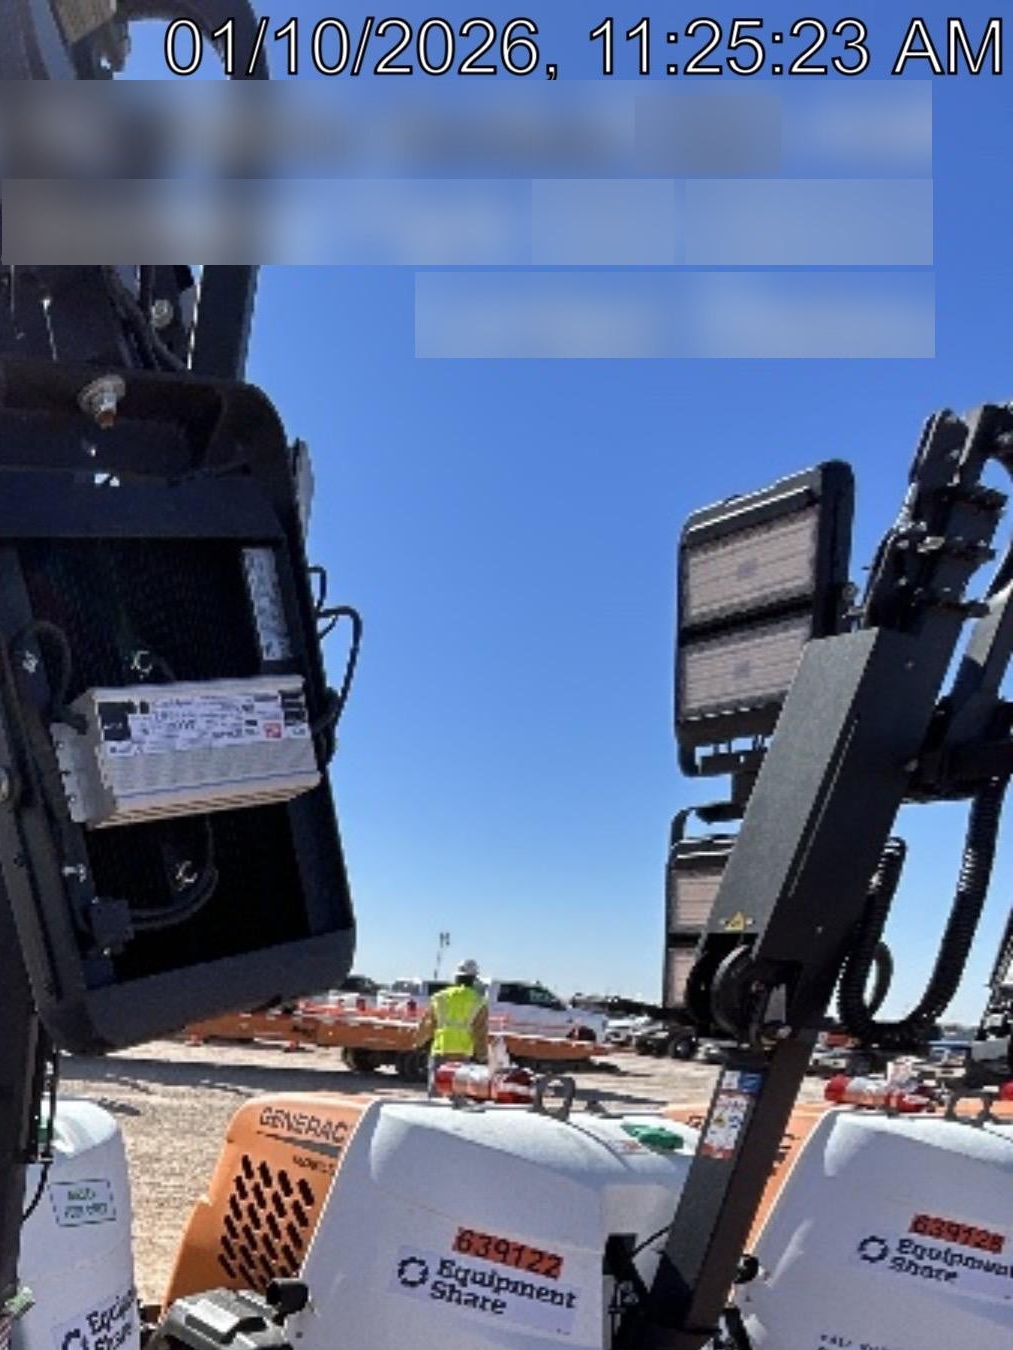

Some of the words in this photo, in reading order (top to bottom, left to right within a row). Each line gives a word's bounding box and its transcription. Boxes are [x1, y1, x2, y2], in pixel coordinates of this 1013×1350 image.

[259, 1106, 347, 1143] GENERAC
[456, 1229, 563, 1280] 639122
[430, 1281, 507, 1315] Share
[437, 1257, 576, 1309] Equipment
